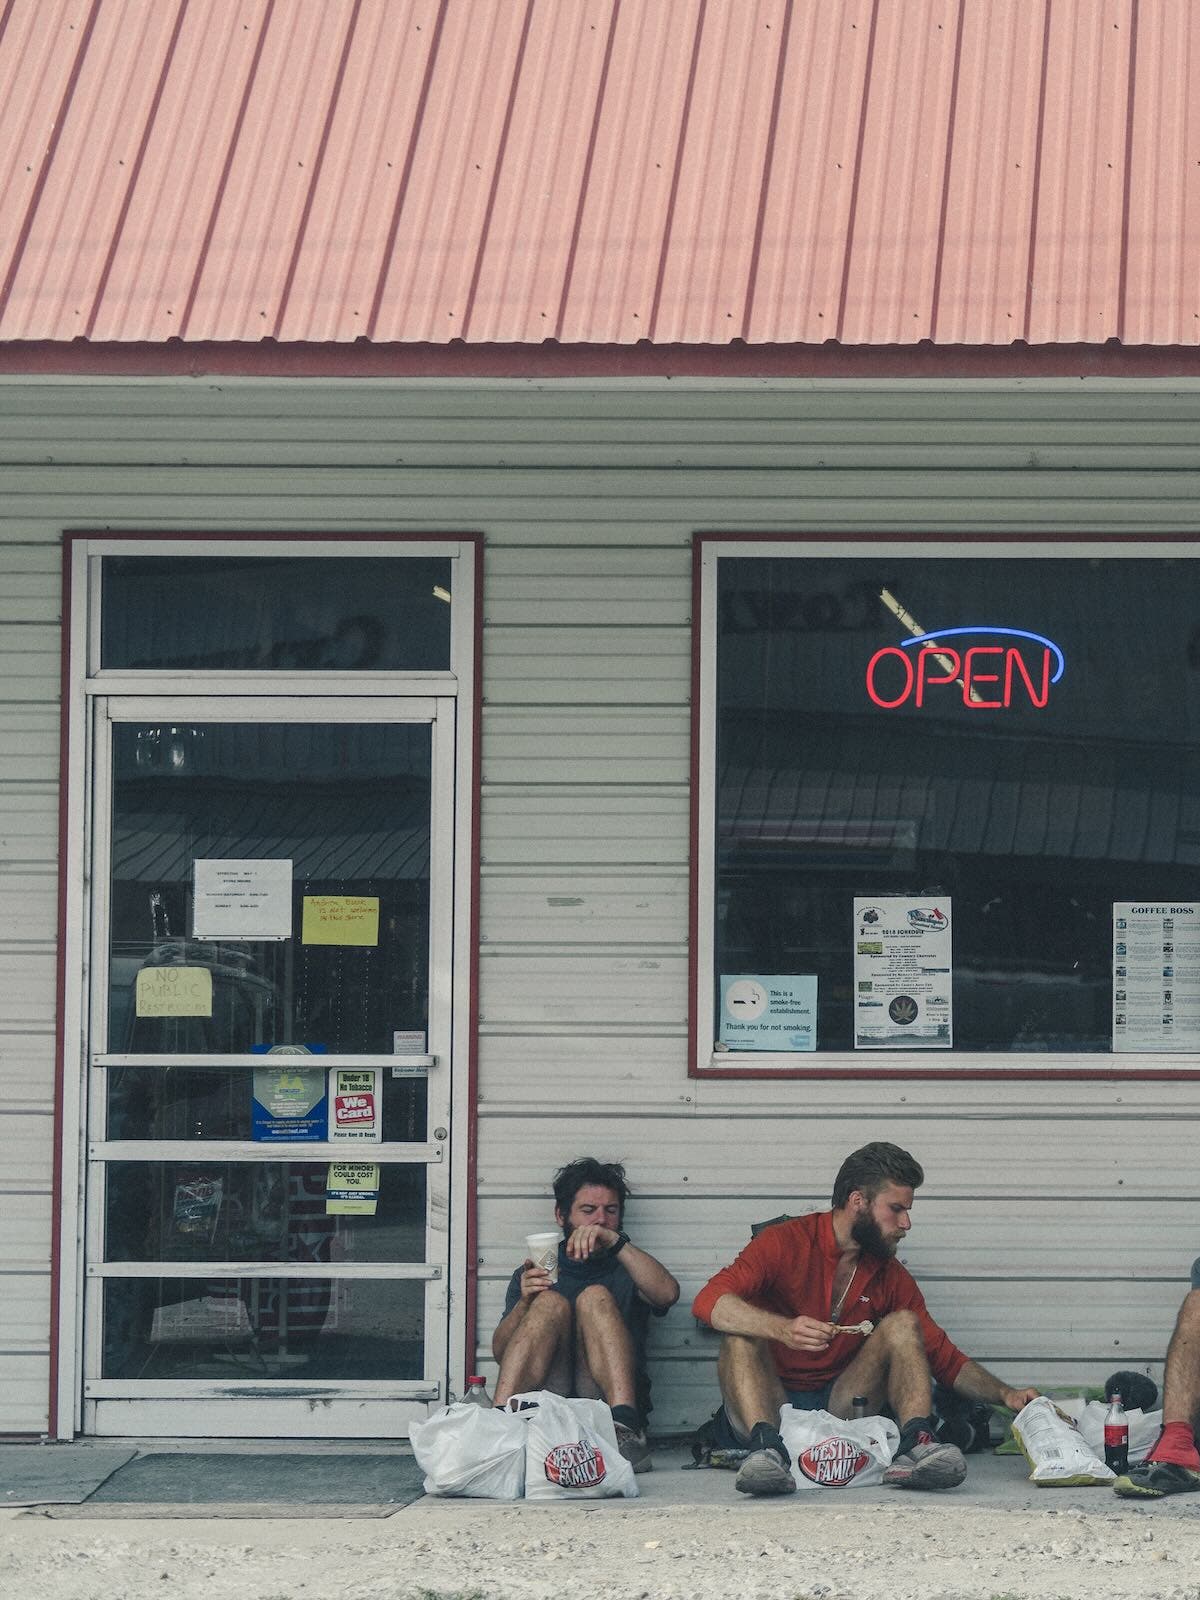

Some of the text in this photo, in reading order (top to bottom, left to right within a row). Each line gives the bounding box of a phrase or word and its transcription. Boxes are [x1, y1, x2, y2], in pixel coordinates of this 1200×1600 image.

[866, 647, 1050, 708] OPEN
[156, 968, 178, 982] NO
[141, 983, 201, 998] PUBLIC
[726, 1022, 745, 1030] Thank
[760, 1023, 769, 1031] for
[783, 1024, 812, 1032] smoking.
[342, 1073, 370, 1082] Under 18
[340, 1083, 372, 1091] No Tobacco
[342, 1096, 368, 1109] We
[337, 1105, 373, 1119] Card
[558, 1458, 600, 1487] FAMILY
